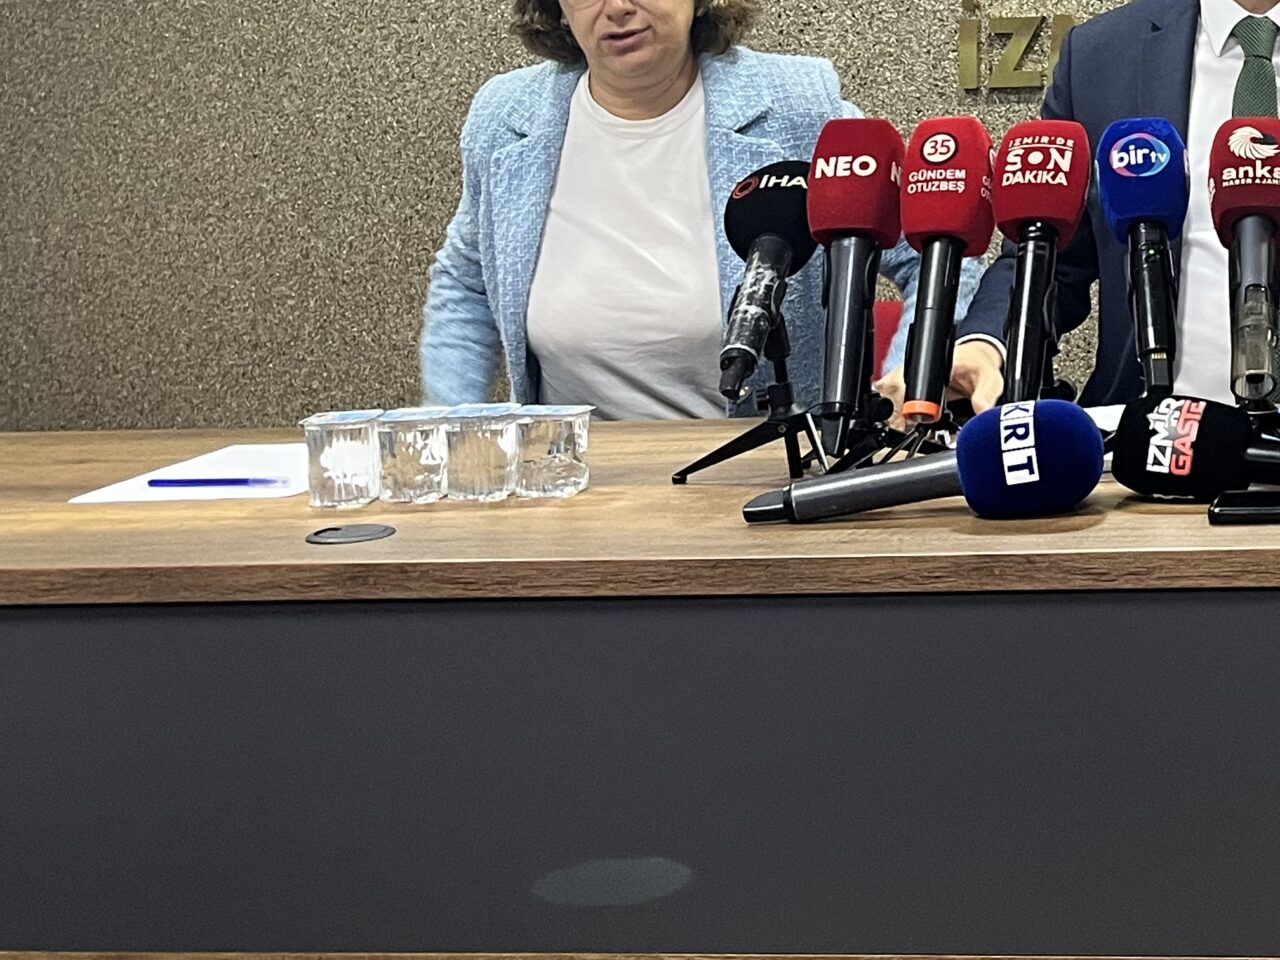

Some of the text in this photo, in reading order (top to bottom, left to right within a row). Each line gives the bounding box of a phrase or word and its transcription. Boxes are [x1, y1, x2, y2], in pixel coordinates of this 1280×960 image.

[927, 139, 952, 156] 35
[1111, 144, 1168, 169] bir tv
[815, 155, 877, 179] NEO
[908, 169, 966, 182] GÜNDEM
[907, 180, 966, 194] OTUZBEŞ
[1003, 404, 1035, 475] KRT
[1170, 400, 1207, 476] GASTE
